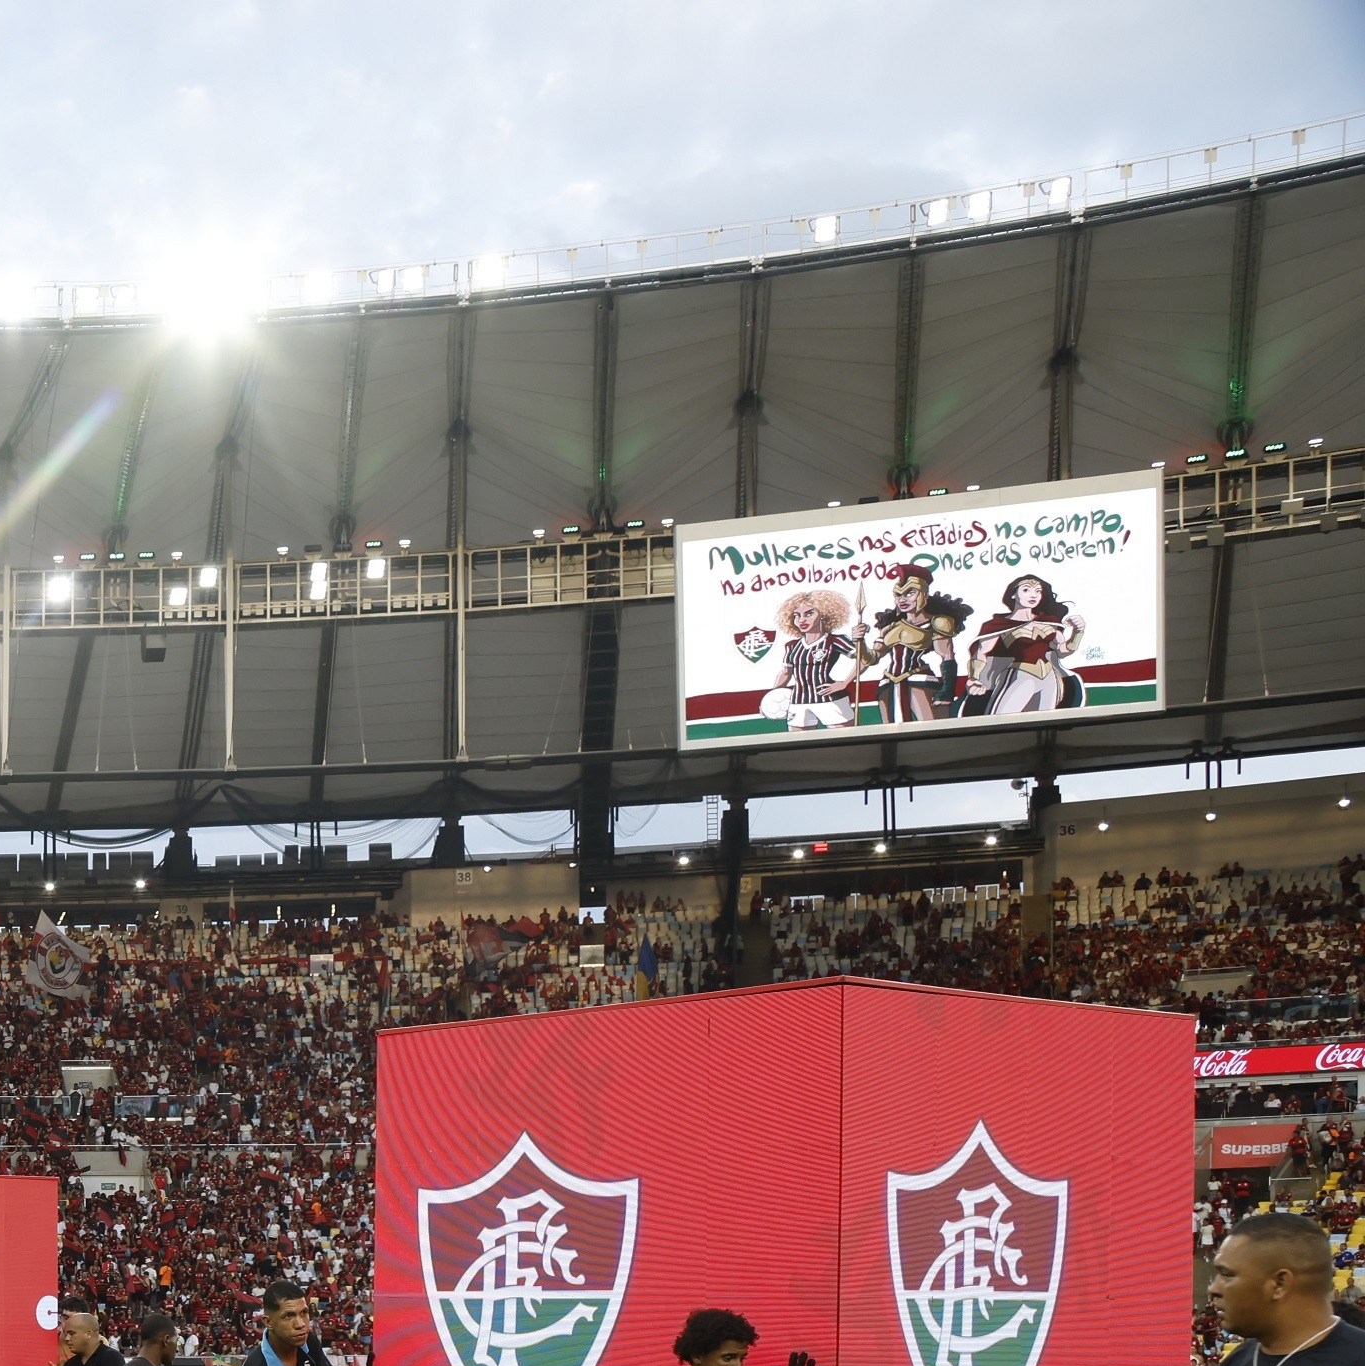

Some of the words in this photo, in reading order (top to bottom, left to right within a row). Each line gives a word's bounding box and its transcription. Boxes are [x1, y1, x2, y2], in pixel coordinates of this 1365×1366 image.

[709, 537, 855, 575] Mulheres
[858, 531, 896, 553] nos
[995, 521, 1027, 540] no
[720, 580, 745, 596] na
[979, 542, 1022, 566] elas
[1059, 825, 1075, 836] 36
[457, 872, 472, 883] 38
[176, 904, 188, 915] 39
[1221, 1142, 1289, 1155] SUPERBE
